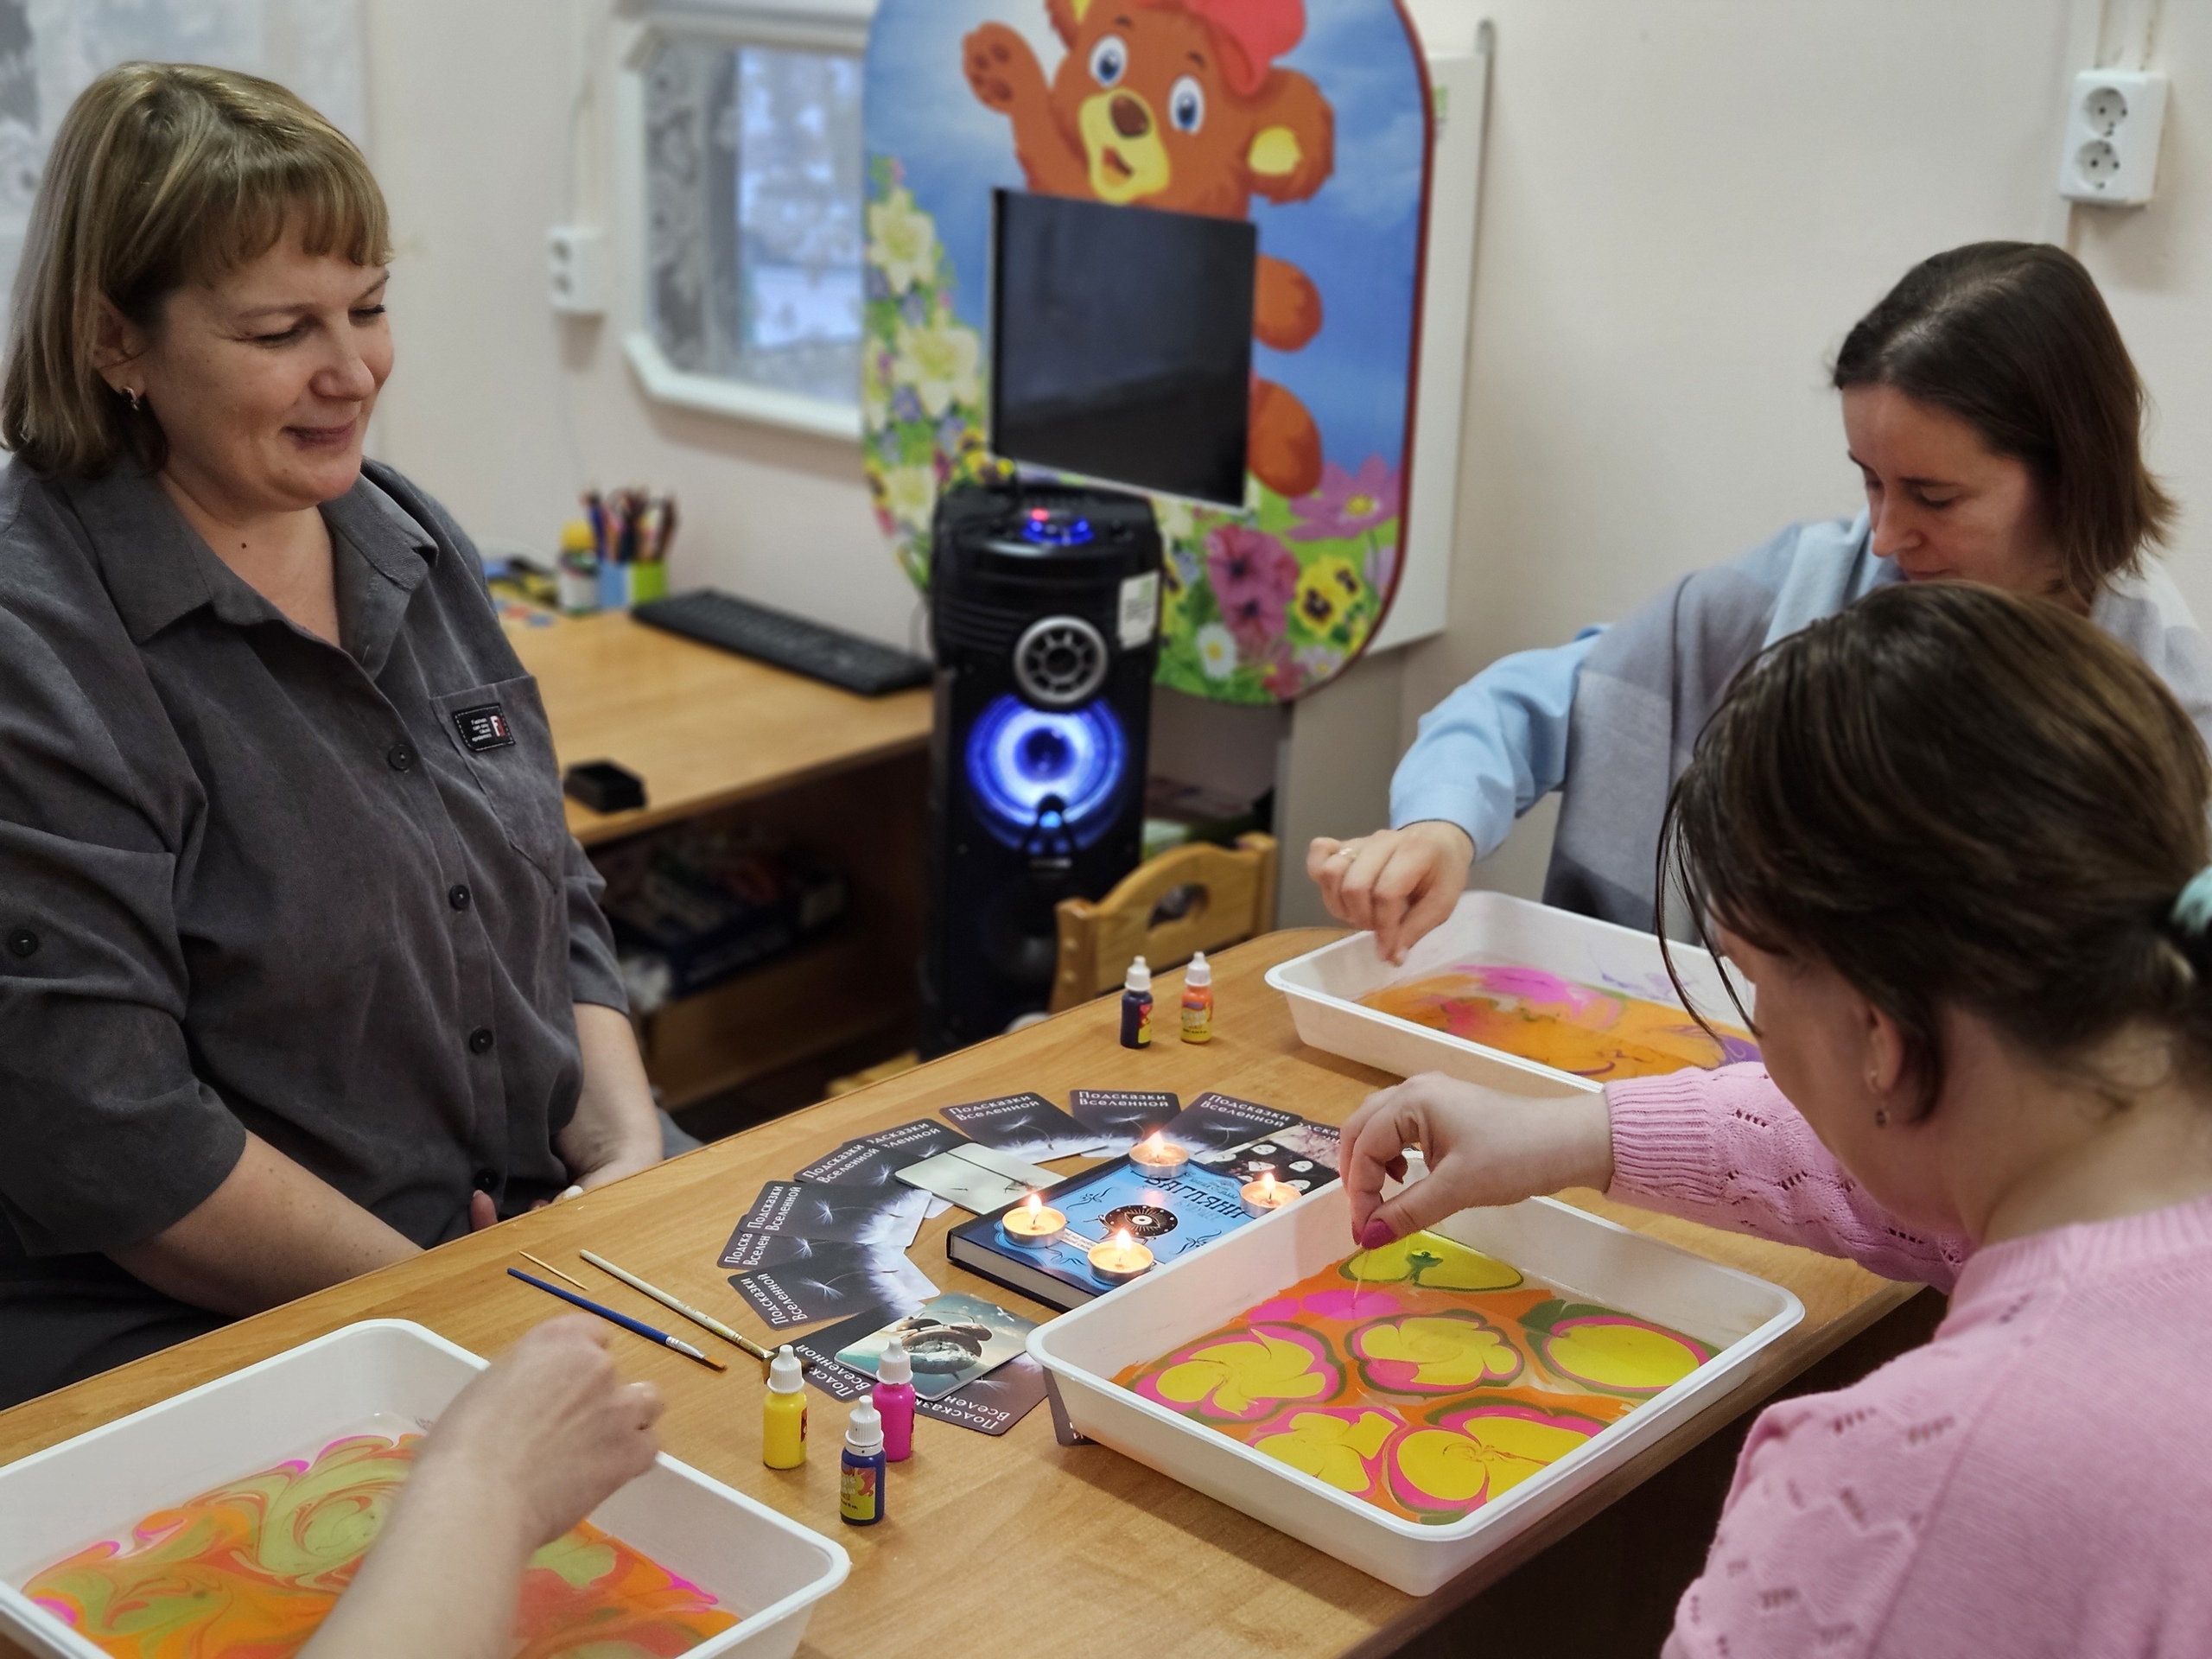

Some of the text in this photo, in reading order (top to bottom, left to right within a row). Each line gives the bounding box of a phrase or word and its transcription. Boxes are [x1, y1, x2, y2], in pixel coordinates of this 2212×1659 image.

[949, 1096, 1032, 1115] Подсказки
[955, 1101, 1039, 1121] Вселенной
[1079, 1091, 1166, 1101] Подсказки
[1079, 1097, 1169, 1107] Вселенной
[1209, 1094, 1290, 1122] Подсказки
[1200, 1101, 1285, 1127] Вселенной
[802, 1144, 865, 1179] Подсказки
[816, 1148, 880, 1184] Вселенной
[747, 1185, 784, 1229] Подсказки
[764, 1186, 802, 1231] Вселенной
[741, 1277, 790, 1325] Подсказки
[757, 1273, 809, 1321] Вселенной
[795, 1344, 872, 1391] Вселенной
[809, 1368, 855, 1397] Подск
